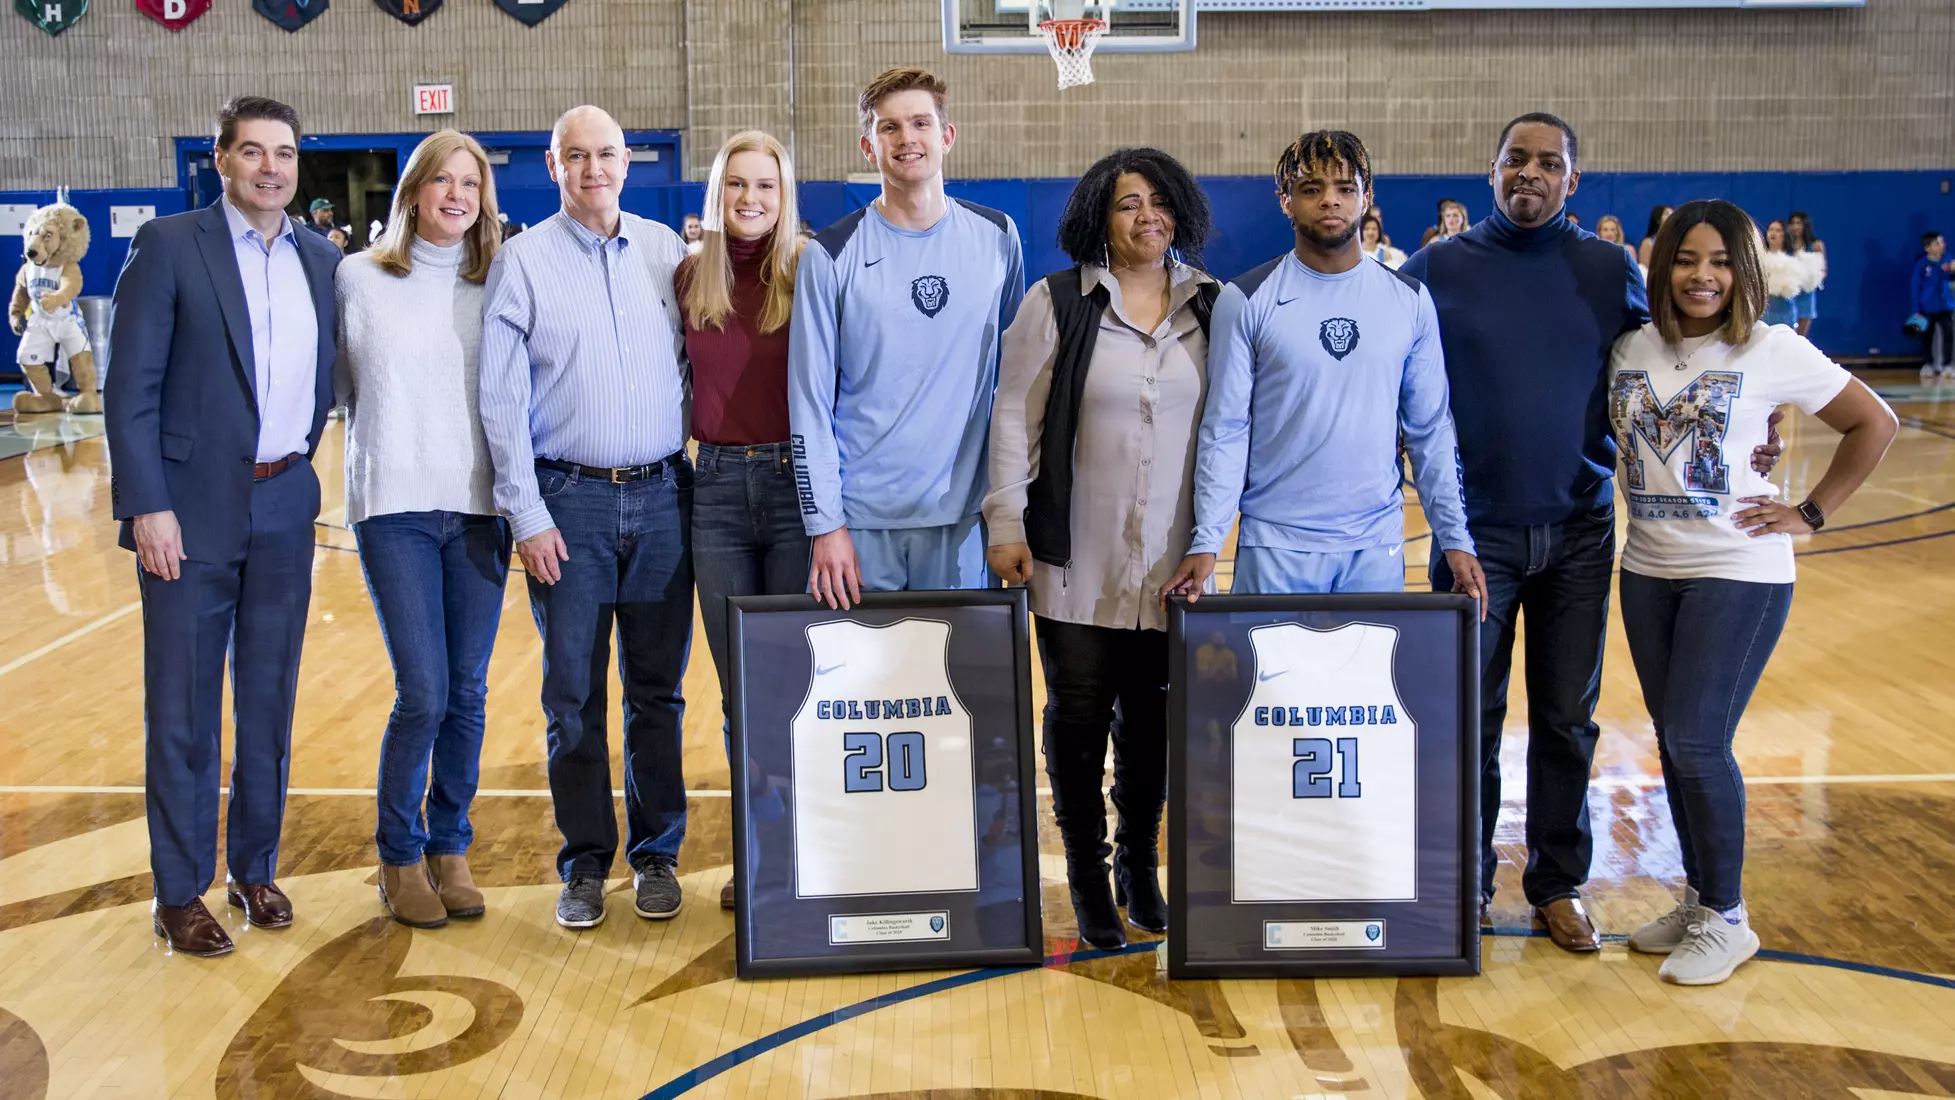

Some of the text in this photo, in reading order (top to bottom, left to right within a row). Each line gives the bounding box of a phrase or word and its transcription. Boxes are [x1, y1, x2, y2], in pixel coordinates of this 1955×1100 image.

[45, 4, 62, 22] H
[164, 0, 187, 19] D
[420, 89, 448, 111] EXIT
[792, 433, 818, 515] COLUMBIA
[817, 696, 951, 720] COLUMBIA
[1255, 705, 1397, 726] COLUMBIA
[844, 731, 927, 793] 20
[1292, 737, 1361, 799] 21
